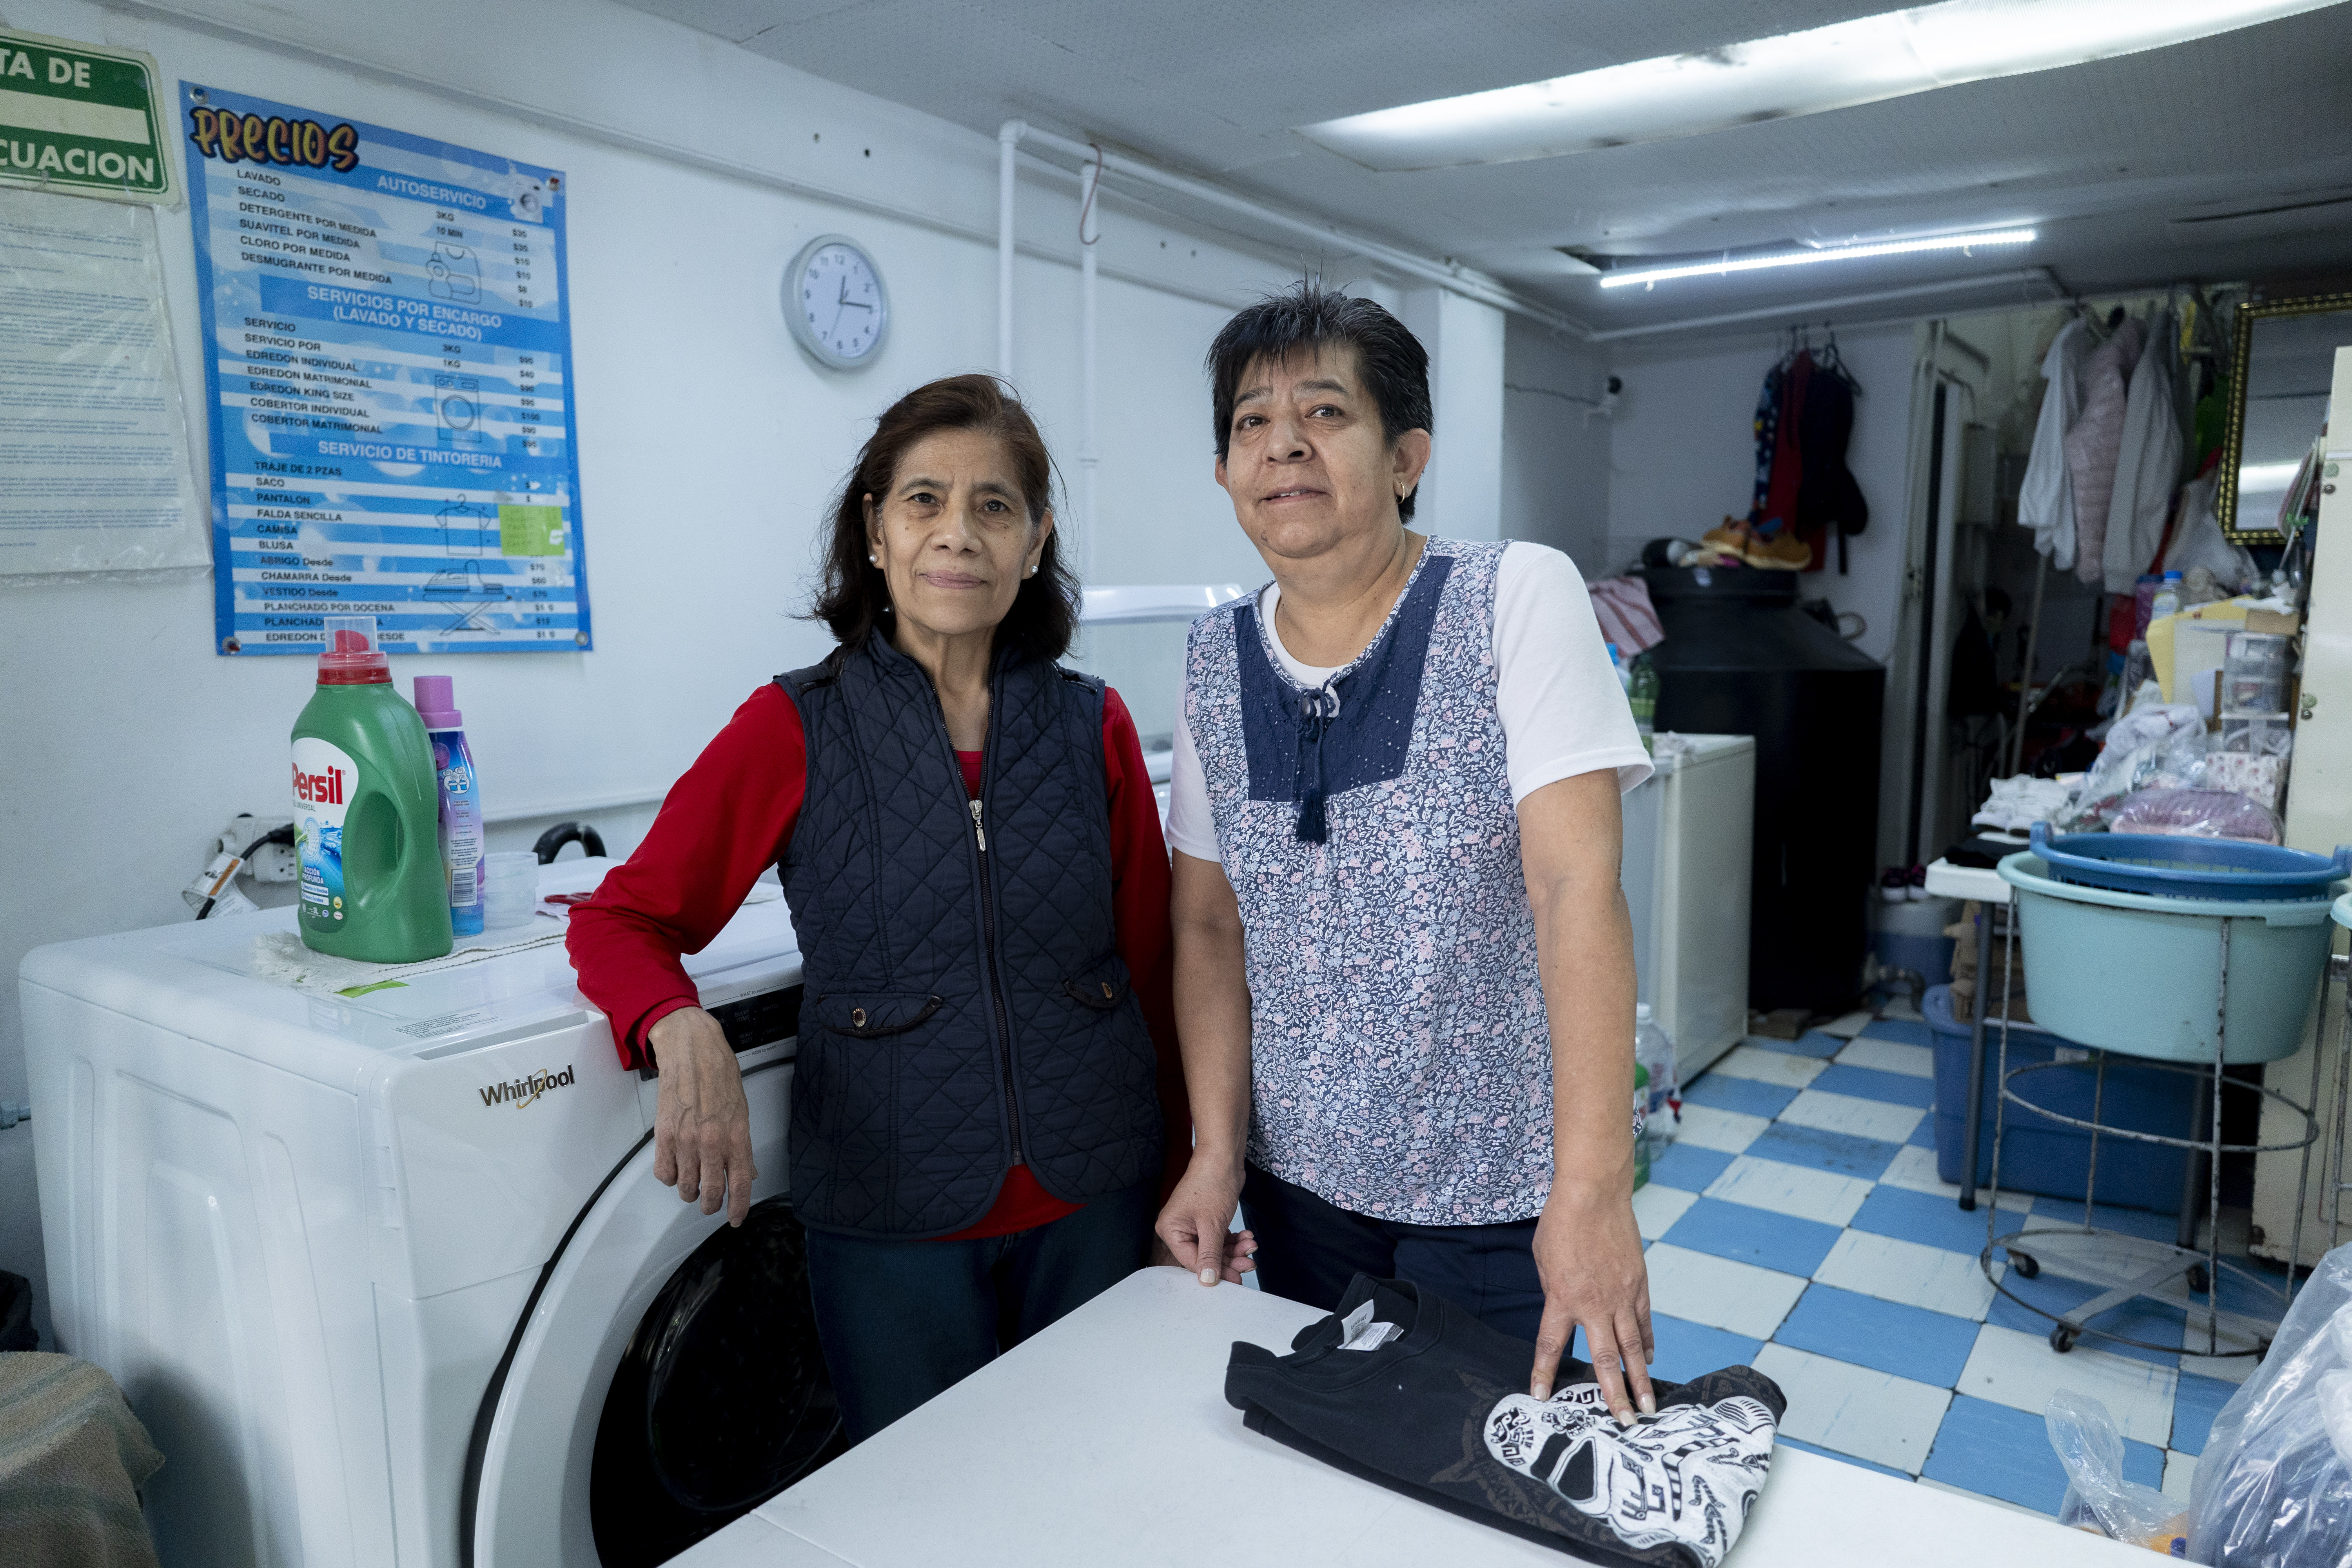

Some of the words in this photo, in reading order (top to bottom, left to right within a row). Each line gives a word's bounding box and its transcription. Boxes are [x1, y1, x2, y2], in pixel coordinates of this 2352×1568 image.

[48, 56, 90, 88] DE
[189, 107, 359, 172] PRECIOS
[237, 169, 281, 186] LAVADO
[238, 185, 285, 202] SECADO
[377, 175, 486, 209] AUTOSERVICIO
[240, 202, 313, 224] DETERGENTE
[315, 216, 336, 228] POR
[339, 221, 377, 238] MEDIDA
[436, 211, 455, 221] 3KG
[240, 219, 293, 236] SUAVITEL
[296, 228, 319, 241] POR
[322, 233, 360, 249] MEDIDA
[436, 226, 446, 236] 10
[447, 229, 463, 239] MIN
[240, 235, 280, 250] CLORO
[283, 241, 307, 253] POR
[309, 247, 350, 261] MEDIDA
[241, 251, 326, 274] DESMUGRANTE
[328, 265, 351, 277] POR
[354, 269, 392, 285] MEDIDA
[307, 286, 393, 311] SERVICIOS
[397, 299, 428, 316] POR
[433, 306, 502, 328] ENCARGO
[244, 317, 296, 332] SERVICIO
[333, 305, 401, 328] (LAVADO
[404, 316, 415, 329] Y
[417, 318, 482, 341] SECADO)
[244, 333, 295, 348] SERVICIO
[298, 340, 321, 352] POR
[443, 343, 461, 354] 3KG
[245, 350, 298, 364] EDREDON
[301, 356, 359, 372] INDIVIDUAL
[443, 359, 461, 368] 1KG
[247, 365, 301, 379] EDREDON
[303, 372, 372, 389] MATRIMONIAL
[249, 381, 301, 395] EDREDON
[303, 388, 330, 399] KING
[332, 391, 355, 402] SIZE
[250, 397, 308, 412] COBERTOR
[310, 404, 370, 418] INDIVIDUAL
[251, 413, 310, 428] COBERTOR
[312, 420, 382, 435] MATRIMONIAL
[318, 440, 392, 459] SERVICIO
[396, 448, 417, 461] DE
[420, 449, 502, 468] TINTORERIA
[255, 461, 287, 473] TRAJE
[290, 464, 305, 474] DE
[307, 465, 312, 474] 2
[315, 466, 342, 476] PZAS
[256, 477, 285, 487] SACO
[257, 493, 310, 505] PANTALON
[257, 509, 291, 519] FALDA
[294, 510, 342, 522] SENCILLA
[257, 524, 298, 535] CAMISA
[259, 540, 294, 550] BLUSA
[261, 556, 299, 566] ABRIGO
[303, 557, 333, 566] Desde
[261, 571, 319, 581] CHAMARRA
[322, 573, 352, 582] Desde
[263, 588, 306, 597] VESTIDO
[264, 602, 328, 612] PLANCHADO
[330, 603, 350, 612] POR
[354, 603, 395, 612] DOCENA
[264, 617, 324, 626] PLANCHAD
[266, 633, 318, 642] EDREDON
[292, 762, 343, 805] Persil
[304, 866, 320, 876] ACCIÓN
[735, 1009, 750, 1017] BULKY
[478, 1063, 575, 1108] Whirlpool
